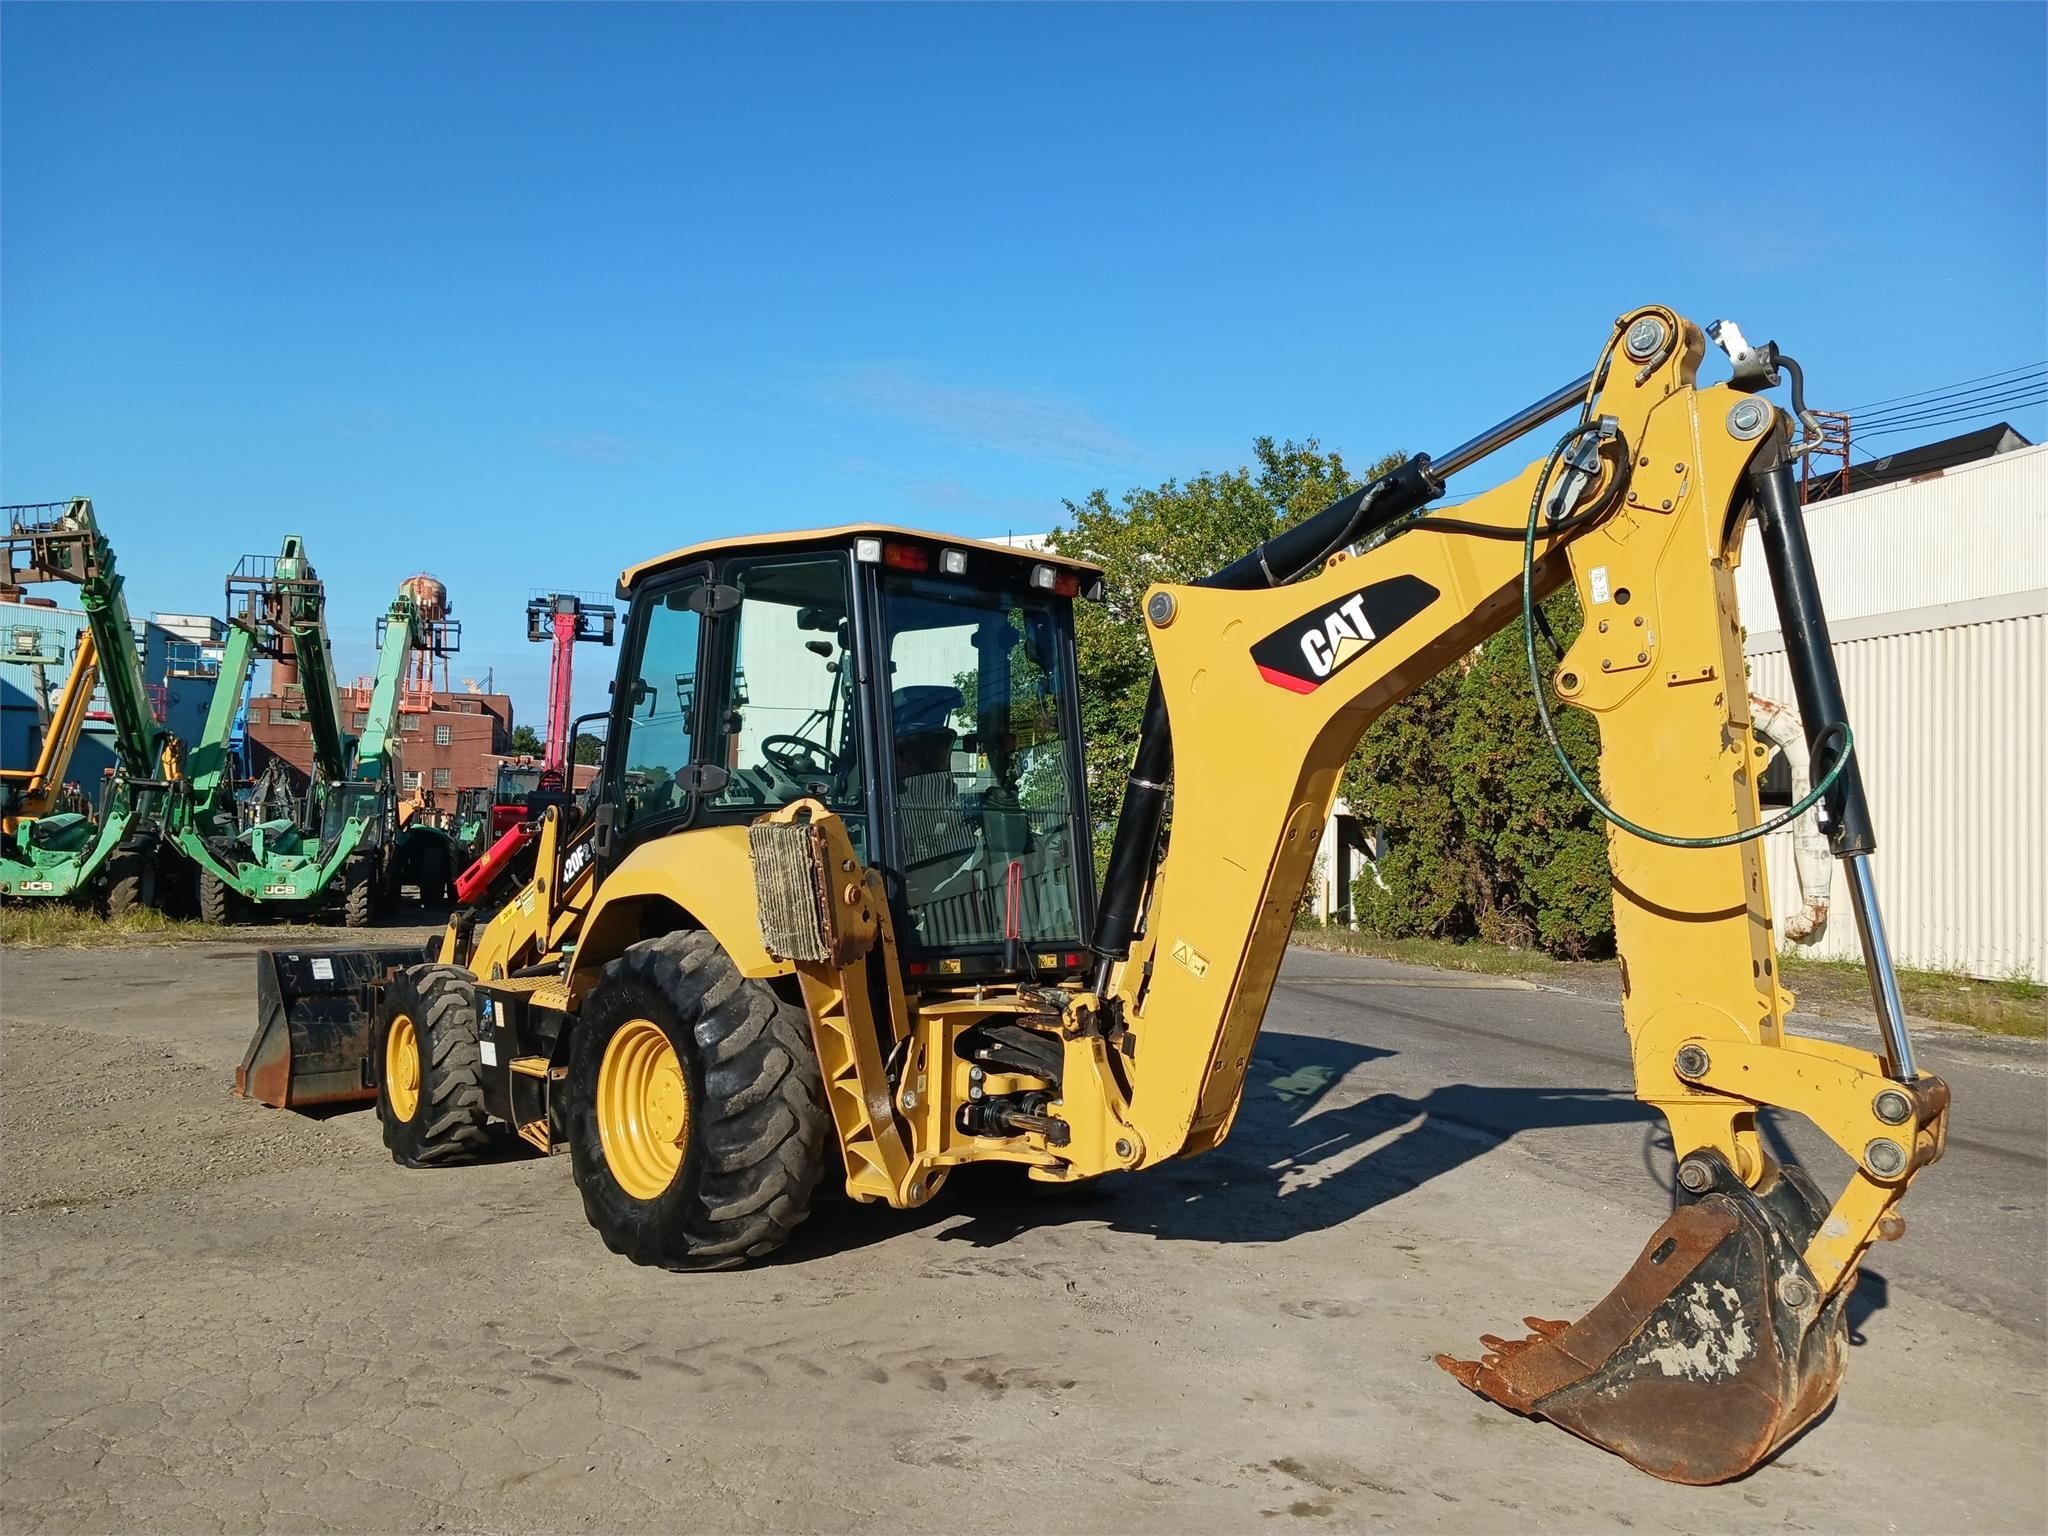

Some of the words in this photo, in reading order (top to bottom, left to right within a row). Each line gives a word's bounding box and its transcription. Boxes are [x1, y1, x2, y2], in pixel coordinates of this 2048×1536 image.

[1301, 593, 1376, 677] CAT
[20, 881, 53, 890] JCB
[265, 885, 296, 895] JCB
